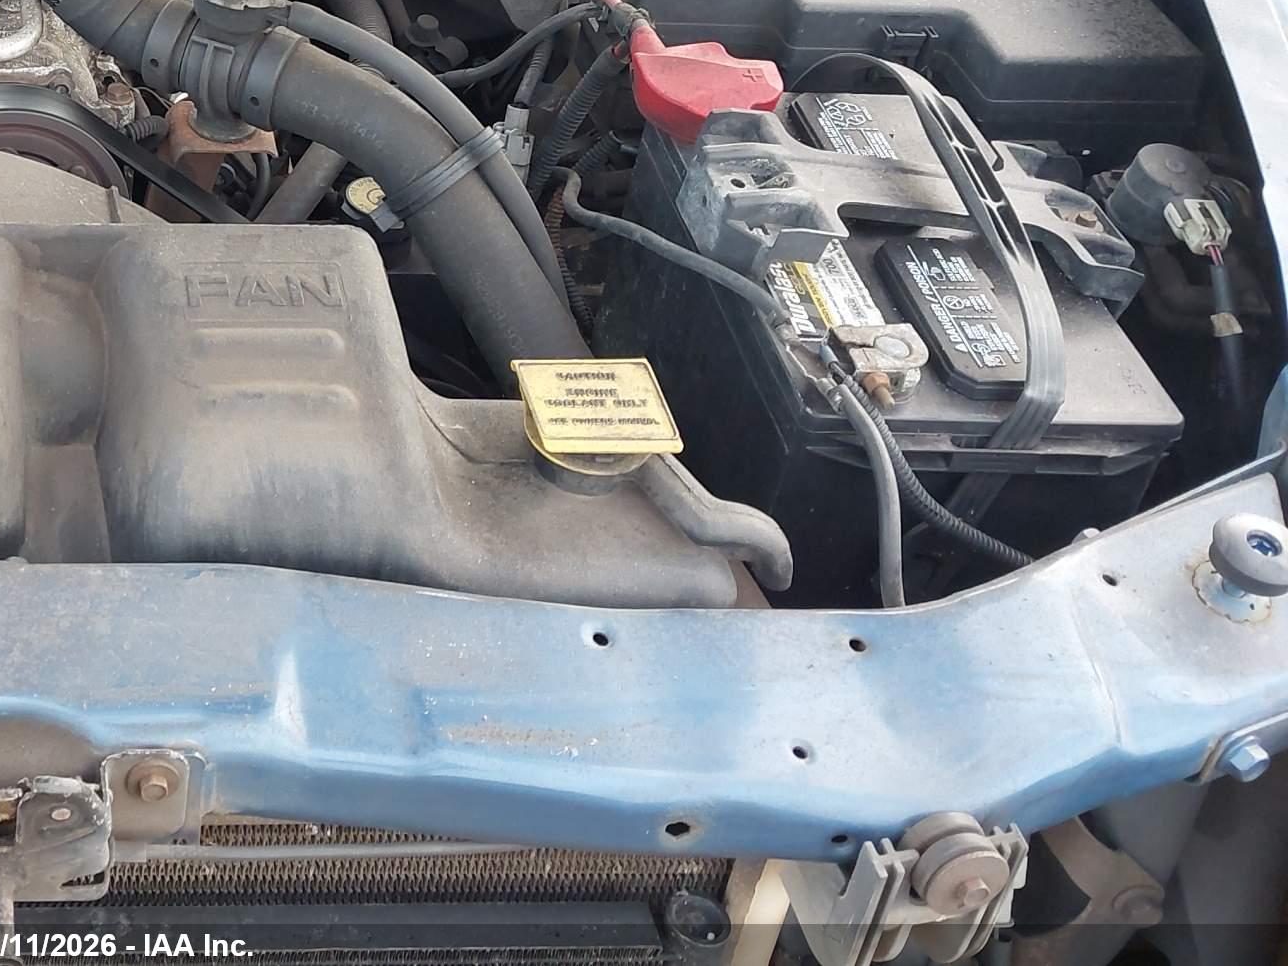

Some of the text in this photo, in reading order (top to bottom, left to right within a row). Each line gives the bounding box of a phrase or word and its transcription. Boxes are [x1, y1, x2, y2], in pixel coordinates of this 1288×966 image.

[823, 257, 839, 274] 700
[905, 261, 934, 295] POISON
[184, 274, 344, 307] FAN
[931, 304, 962, 342] DANGER
